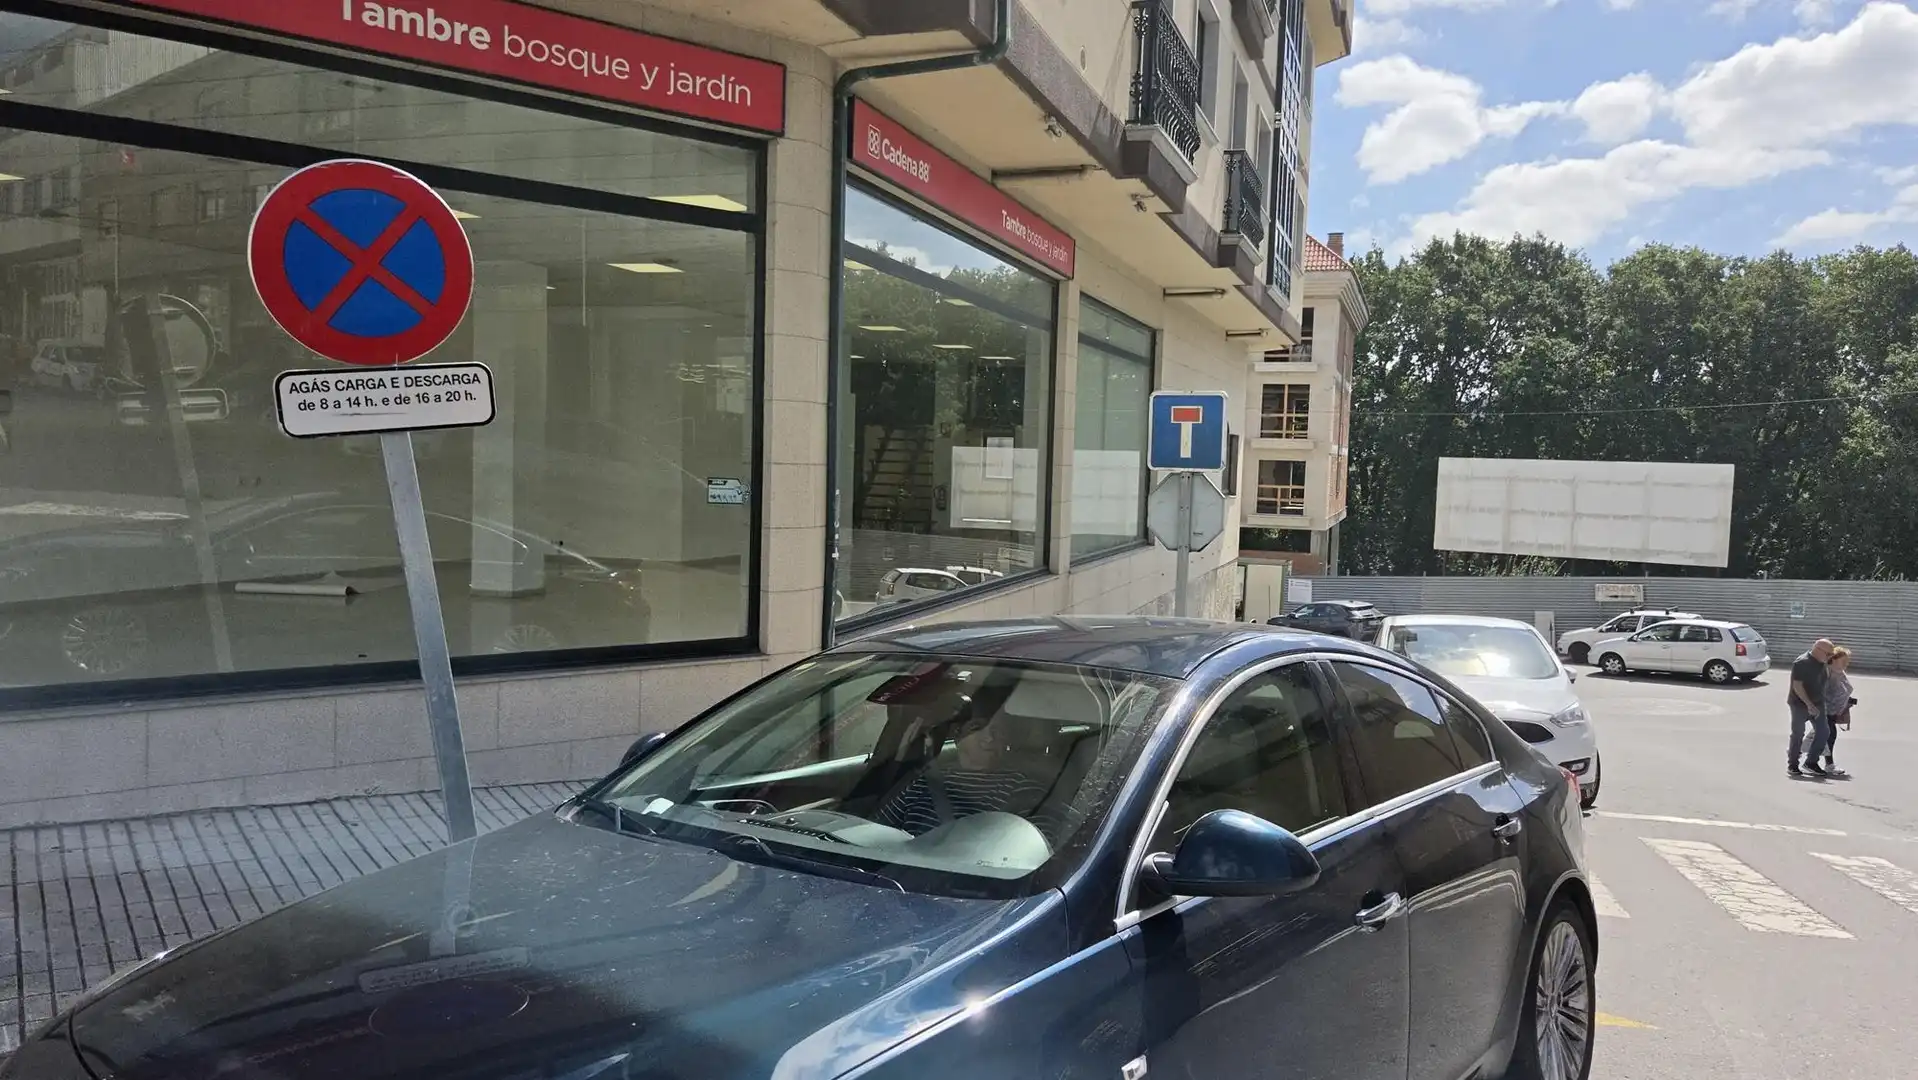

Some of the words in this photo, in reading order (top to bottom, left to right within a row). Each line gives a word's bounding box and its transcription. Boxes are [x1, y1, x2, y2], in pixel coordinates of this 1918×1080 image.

[503, 25, 630, 79] bosque
[640, 63, 660, 90] y
[667, 63, 752, 106] jardín
[882, 138, 918, 177] Cadena
[918, 160, 930, 183] 88
[1001, 209, 1027, 239] Tambre
[1027, 225, 1048, 253] bosque
[289, 378, 331, 394] AGÁS
[334, 377, 387, 392] CARGA
[391, 377, 400, 388] E
[404, 373, 481, 388] DESCARGA
[298, 400, 316, 411] de
[320, 399, 329, 410] 8
[333, 401, 341, 409] a
[346, 397, 362, 408] 14
[365, 396, 377, 407] h.
[382, 398, 390, 406] e
[394, 394, 411, 405] de
[416, 392, 430, 404] 16
[434, 394, 442, 403] a
[445, 391, 461, 402] 20
[464, 390, 477, 401] h.
